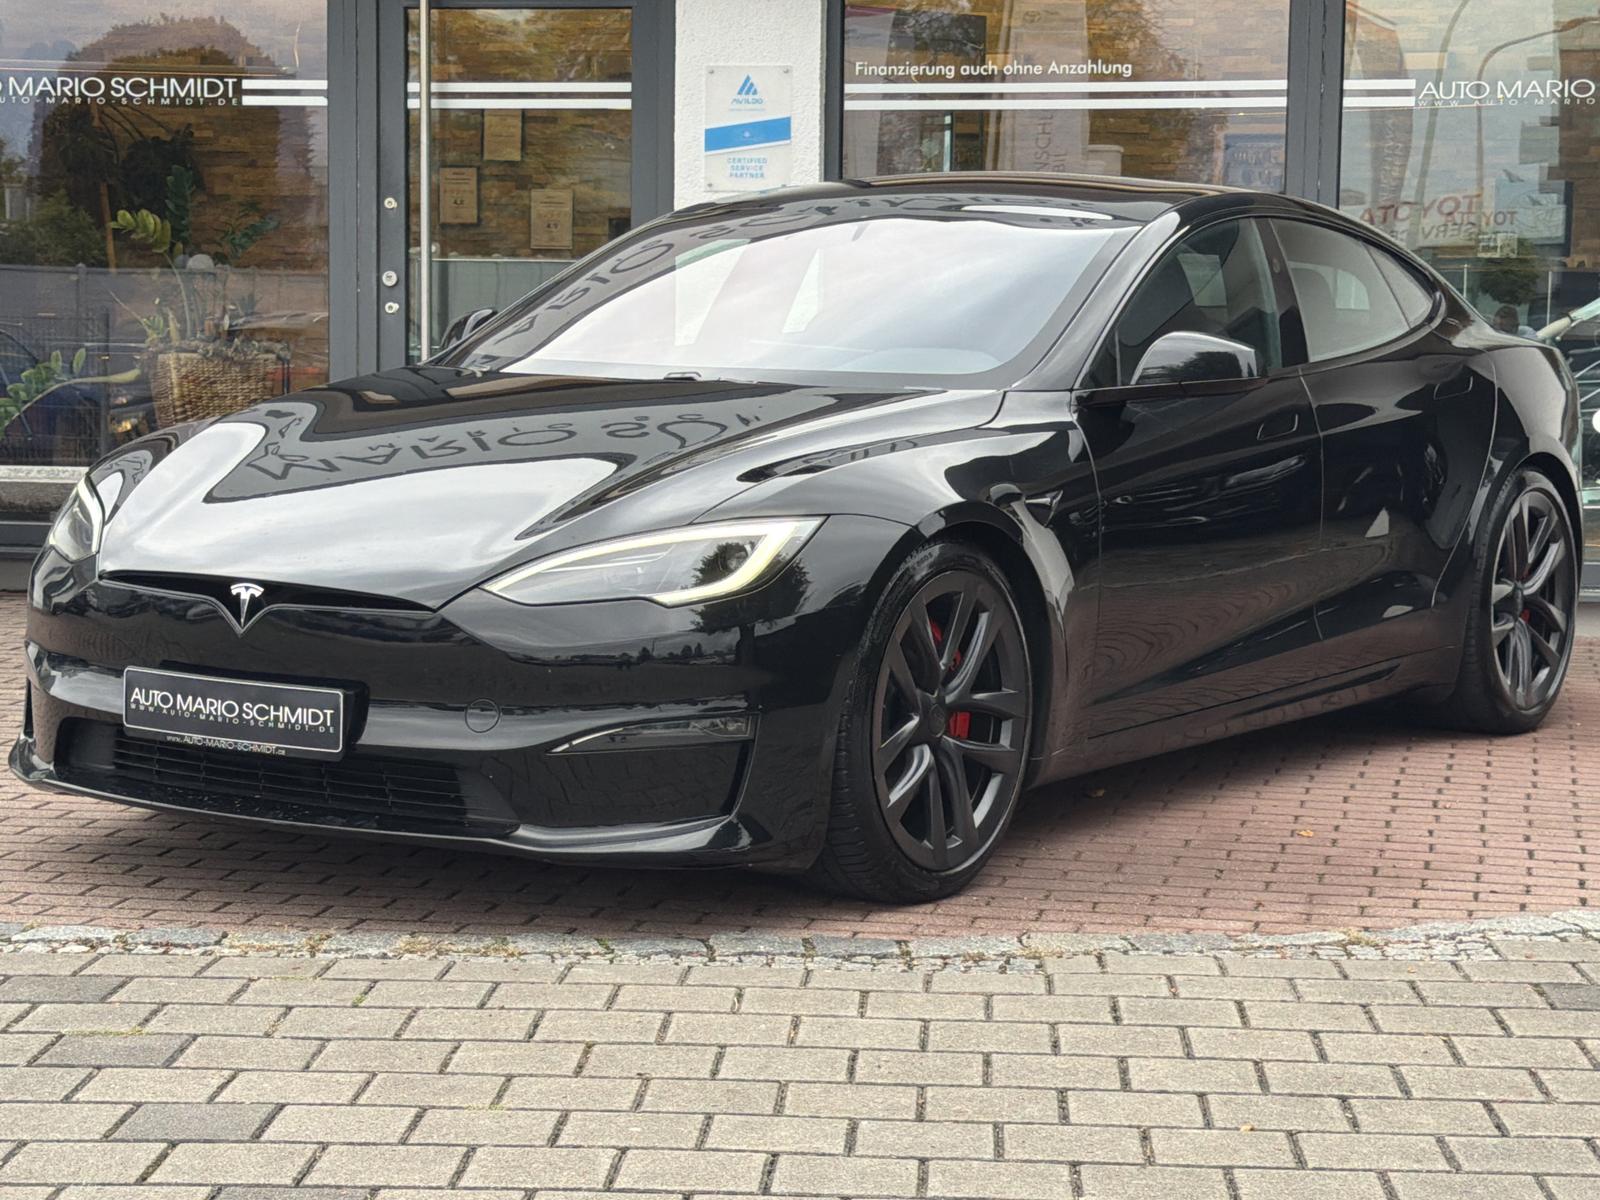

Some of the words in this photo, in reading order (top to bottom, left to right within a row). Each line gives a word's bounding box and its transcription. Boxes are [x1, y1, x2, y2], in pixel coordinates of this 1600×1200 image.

[855, 61, 955, 79] Finanzierung
[960, 61, 998, 76] auch
[1003, 60, 1043, 75] ohne
[1047, 59, 1132, 77] Anzahlung
[8, 76, 105, 97] MARIO
[110, 77, 237, 98] SCHMIDT
[1418, 81, 1490, 99] AUTO
[1497, 79, 1596, 98] MARIO
[727, 157, 768, 165] CERTIFIED
[130, 687, 173, 709] AUTO
[176, 693, 239, 718] MARIO
[242, 702, 335, 727] SCHMIDT
